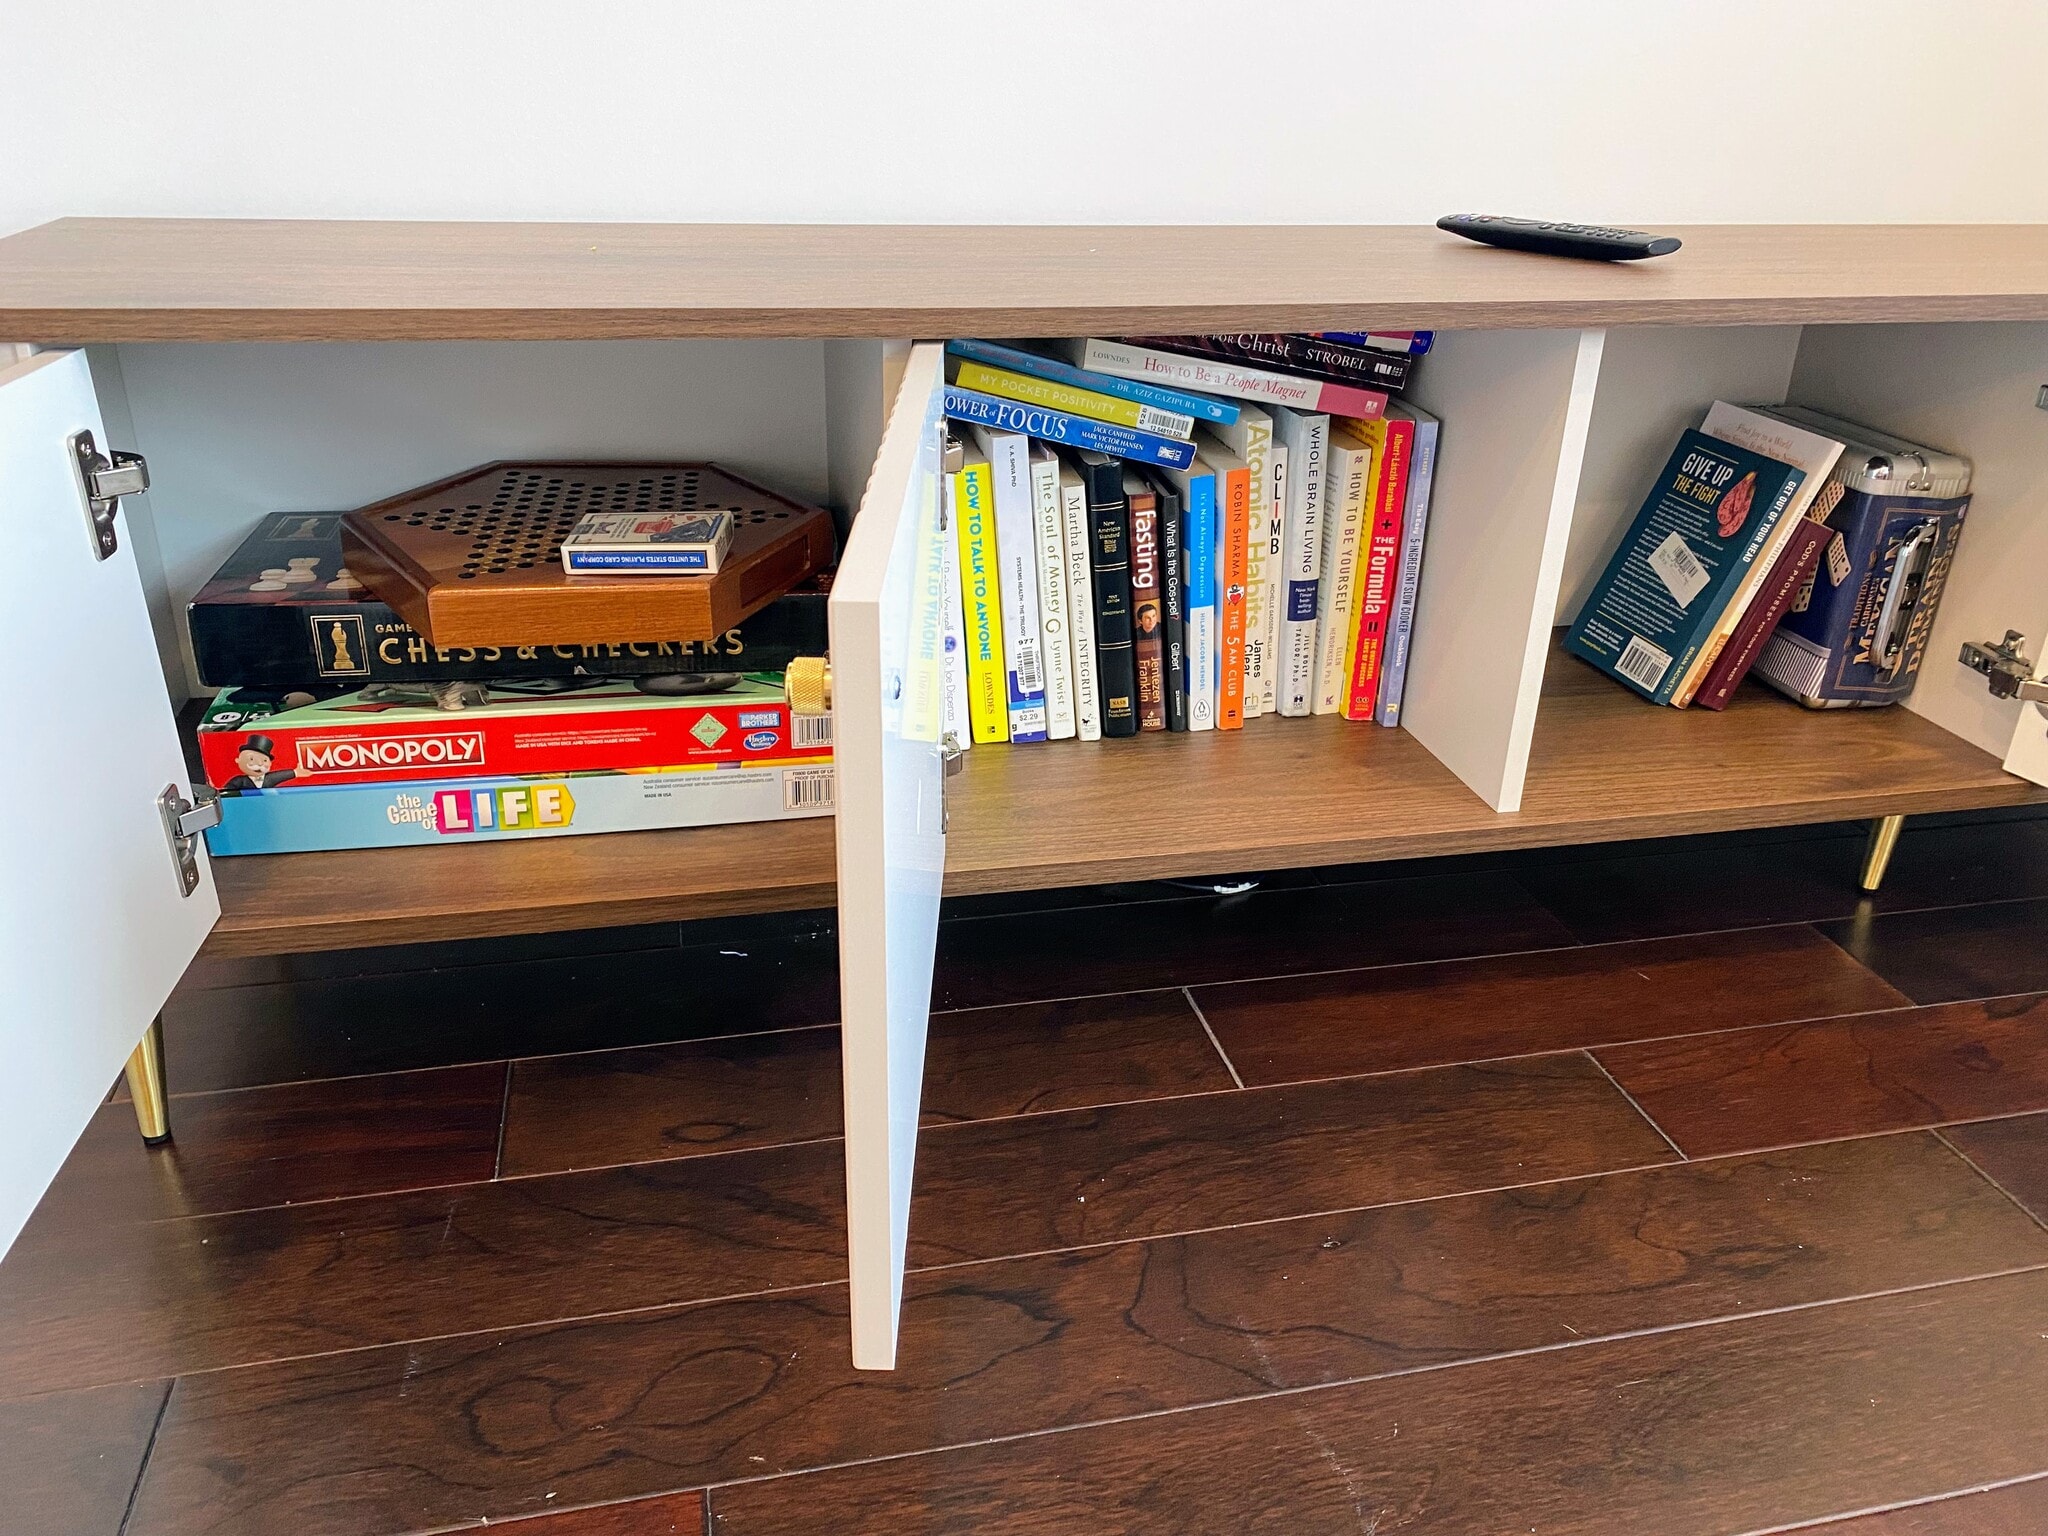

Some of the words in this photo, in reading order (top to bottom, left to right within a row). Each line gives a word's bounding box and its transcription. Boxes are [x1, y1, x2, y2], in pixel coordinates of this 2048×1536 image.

[1093, 351, 1130, 364] LOWNDES
[1238, 334, 1290, 358] Christ
[1306, 348, 1366, 371] STROBEL
[980, 373, 996, 387] MY
[1001, 380, 1048, 400] POCKET
[1052, 391, 1117, 415] POSITIVITY
[1144, 357, 1173, 374] How
[1178, 367, 1190, 378] to
[1195, 368, 1211, 382] Be
[1214, 374, 1220, 383] a
[1224, 372, 1260, 392] People
[1262, 380, 1307, 400] Magnet
[1116, 383, 1131, 393] DR.
[1133, 388, 1152, 399] AZIZ
[1154, 393, 1196, 410] GAZIPURA
[945, 395, 988, 418] OWER
[996, 403, 1068, 440] FOCUS
[1082, 432, 1098, 440] MARK
[1098, 435, 1118, 445] VICTOR
[1119, 440, 1144, 450] HANSEN
[1094, 426, 1106, 434] JACK
[1107, 429, 1136, 441] CANFIELD
[1106, 444, 1126, 454] HEWITT
[1308, 426, 1321, 478] WHOLE
[1388, 433, 1404, 481] Albert-László
[1248, 424, 1270, 530] Atomic
[1682, 453, 1712, 480] GIVE
[1712, 465, 1734, 487] UP
[965, 472, 980, 510] HOW
[1042, 472, 1054, 500] The
[1350, 472, 1362, 500] HOW
[1384, 482, 1397, 513] Barabási
[1672, 474, 1694, 496] THE
[1693, 482, 1721, 506] FIGHT
[1782, 480, 1796, 496] GET
[1233, 484, 1242, 522] ROBIN
[1306, 483, 1318, 524] BRAIN
[1347, 506, 1358, 522] TO
[1768, 511, 1779, 523] OF
[1775, 495, 1788, 512] OUT
[969, 513, 982, 535] TO
[1044, 506, 1058, 539] Soul
[1068, 497, 1082, 547] Martha
[1166, 520, 1176, 546] What
[1342, 530, 1354, 545] BE
[1412, 518, 1422, 535] Easy
[1755, 522, 1773, 544] YOUR
[1048, 546, 1060, 560] of
[1132, 510, 1156, 589] fasting
[1168, 548, 1176, 558] Is
[1199, 526, 1207, 554] Always
[1232, 528, 1242, 577] SHARMA
[1302, 530, 1314, 573] LIVING
[1743, 542, 1760, 563] HEAD
[1797, 540, 1816, 567] GOD'S
[971, 538, 984, 576] TALK
[1072, 552, 1086, 586] Beck
[1168, 560, 1178, 576] the
[1404, 538, 1420, 584] 5-INGREDIENT
[974, 577, 986, 598] TO
[1048, 566, 1060, 614] Money
[1198, 556, 1207, 598] Depression
[1246, 542, 1266, 629] Habits
[1335, 549, 1352, 613] YOURSELF
[1364, 546, 1394, 614] Formula
[1402, 586, 1414, 605] SLOW
[1850, 572, 1872, 629] TRADITIONS
[976, 602, 992, 661] ANYONE
[1076, 610, 1085, 624] Way
[1230, 610, 1240, 631] THE
[1398, 606, 1412, 634] COOKER
[378, 637, 501, 665] CHESS
[1171, 642, 1180, 671] Gilbert
[1226, 636, 1240, 646] 5
[1395, 636, 1406, 667] Cookbook
[1683, 646, 1696, 665] BRIAN
[1050, 640, 1062, 672] Lynne
[1056, 675, 1066, 705] Twist
[1078, 638, 1092, 706] INTEGRITY
[1228, 648, 1238, 666] AM
[1244, 644, 1254, 676] Clear
[1253, 639, 1264, 678] James
[985, 672, 995, 714] LOWNDES
[1140, 660, 1150, 702] Franklin
[1150, 656, 1160, 703] Jentezen
[1228, 671, 1238, 697] CLUB
[1664, 664, 1684, 695] SACHETTA
[946, 684, 956, 721] Dispenza
[1019, 713, 1038, 722] $2.29
[742, 720, 778, 728] BROTHERS
[748, 734, 776, 744] Hasbro
[306, 738, 477, 769] MONOPOLY
[386, 802, 438, 824] Game
[396, 794, 422, 809] the
[442, 788, 564, 829] LIFE
[422, 818, 438, 832] of
